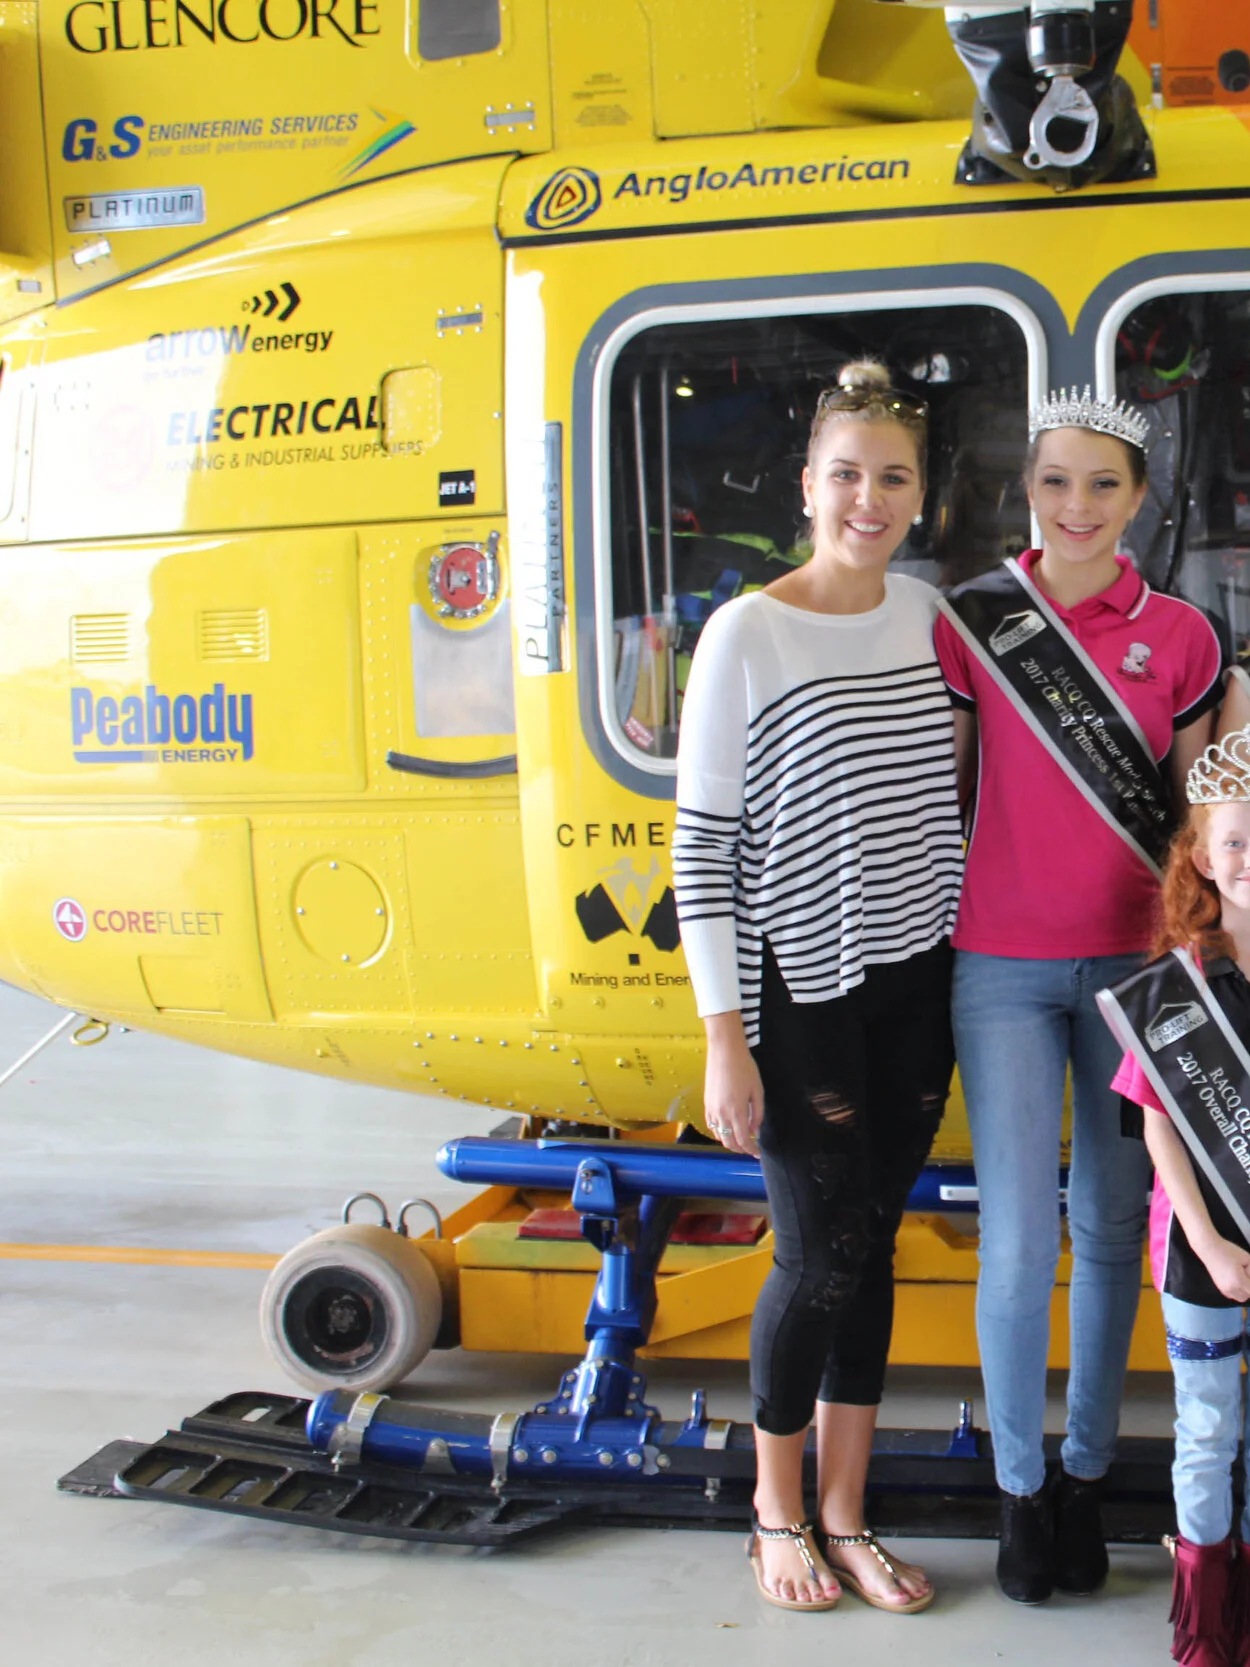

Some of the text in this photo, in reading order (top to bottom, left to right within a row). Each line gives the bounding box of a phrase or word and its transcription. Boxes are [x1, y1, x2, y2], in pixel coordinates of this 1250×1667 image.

[65, 0, 381, 54] GLENCORE
[62, 114, 360, 163] G&S ENGINEERING SERVICES
[148, 135, 349, 159] your asset performance partner
[167, 396, 386, 446] ELECTRICAL
[230, 454, 241, 470] &
[245, 445, 336, 468] INDUSTRIAL
[549, 481, 564, 618] PARTNERS
[70, 683, 253, 761] Peabody
[1020, 657, 1050, 685] 2017
[1042, 685, 1078, 728] Charity
[1071, 725, 1109, 774] Princess
[1052, 666, 1083, 703] RACQ
[1077, 699, 1097, 723] CQ
[1090, 717, 1122, 759] Rescue
[161, 748, 239, 763] ENERGY
[94, 909, 225, 936] COREFLEET
[570, 972, 618, 989] Mining
[623, 973, 650, 987] and
[1176, 1052, 1208, 1085] 2017
[1199, 1086, 1238, 1138] Overall
[1209, 1066, 1242, 1112] RACQ
